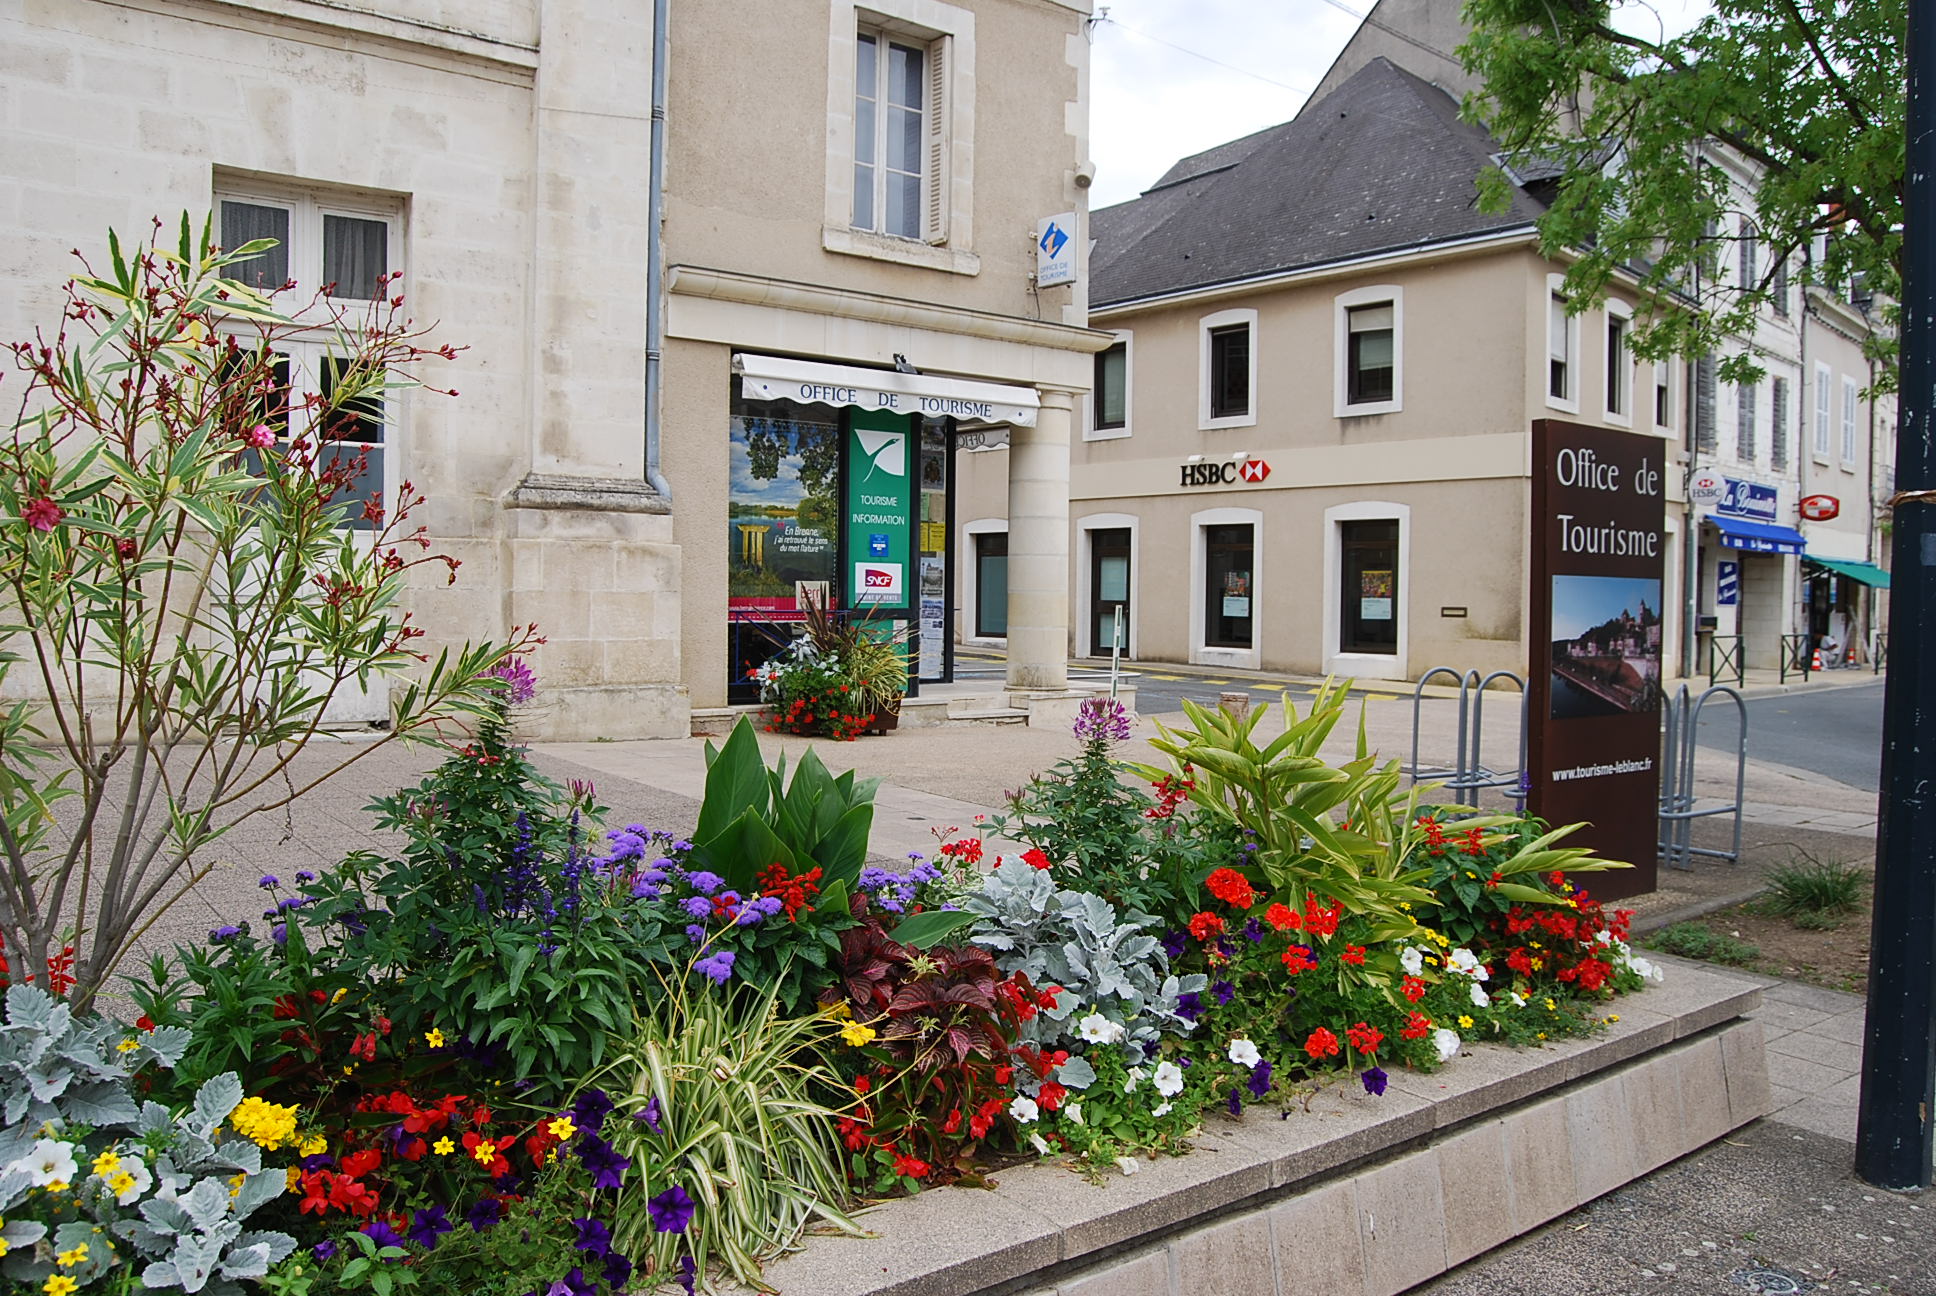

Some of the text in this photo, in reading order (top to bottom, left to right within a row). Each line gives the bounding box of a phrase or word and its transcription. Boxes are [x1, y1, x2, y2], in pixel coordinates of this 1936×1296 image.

[800, 384, 992, 417] OFFICE DE TOURISME
[1180, 461, 1237, 487] HSBC
[1556, 447, 1659, 496] Office de
[1692, 486, 1721, 499] HSBC
[860, 494, 898, 507] TOURISME
[852, 513, 905, 526] INFORMATION
[784, 525, 794, 536] En
[1556, 513, 1658, 558] Tourisme
[779, 544, 788, 552] du
[865, 575, 892, 586] SNCF
[1552, 757, 1653, 782] www.tourisme-leblanc.fr
